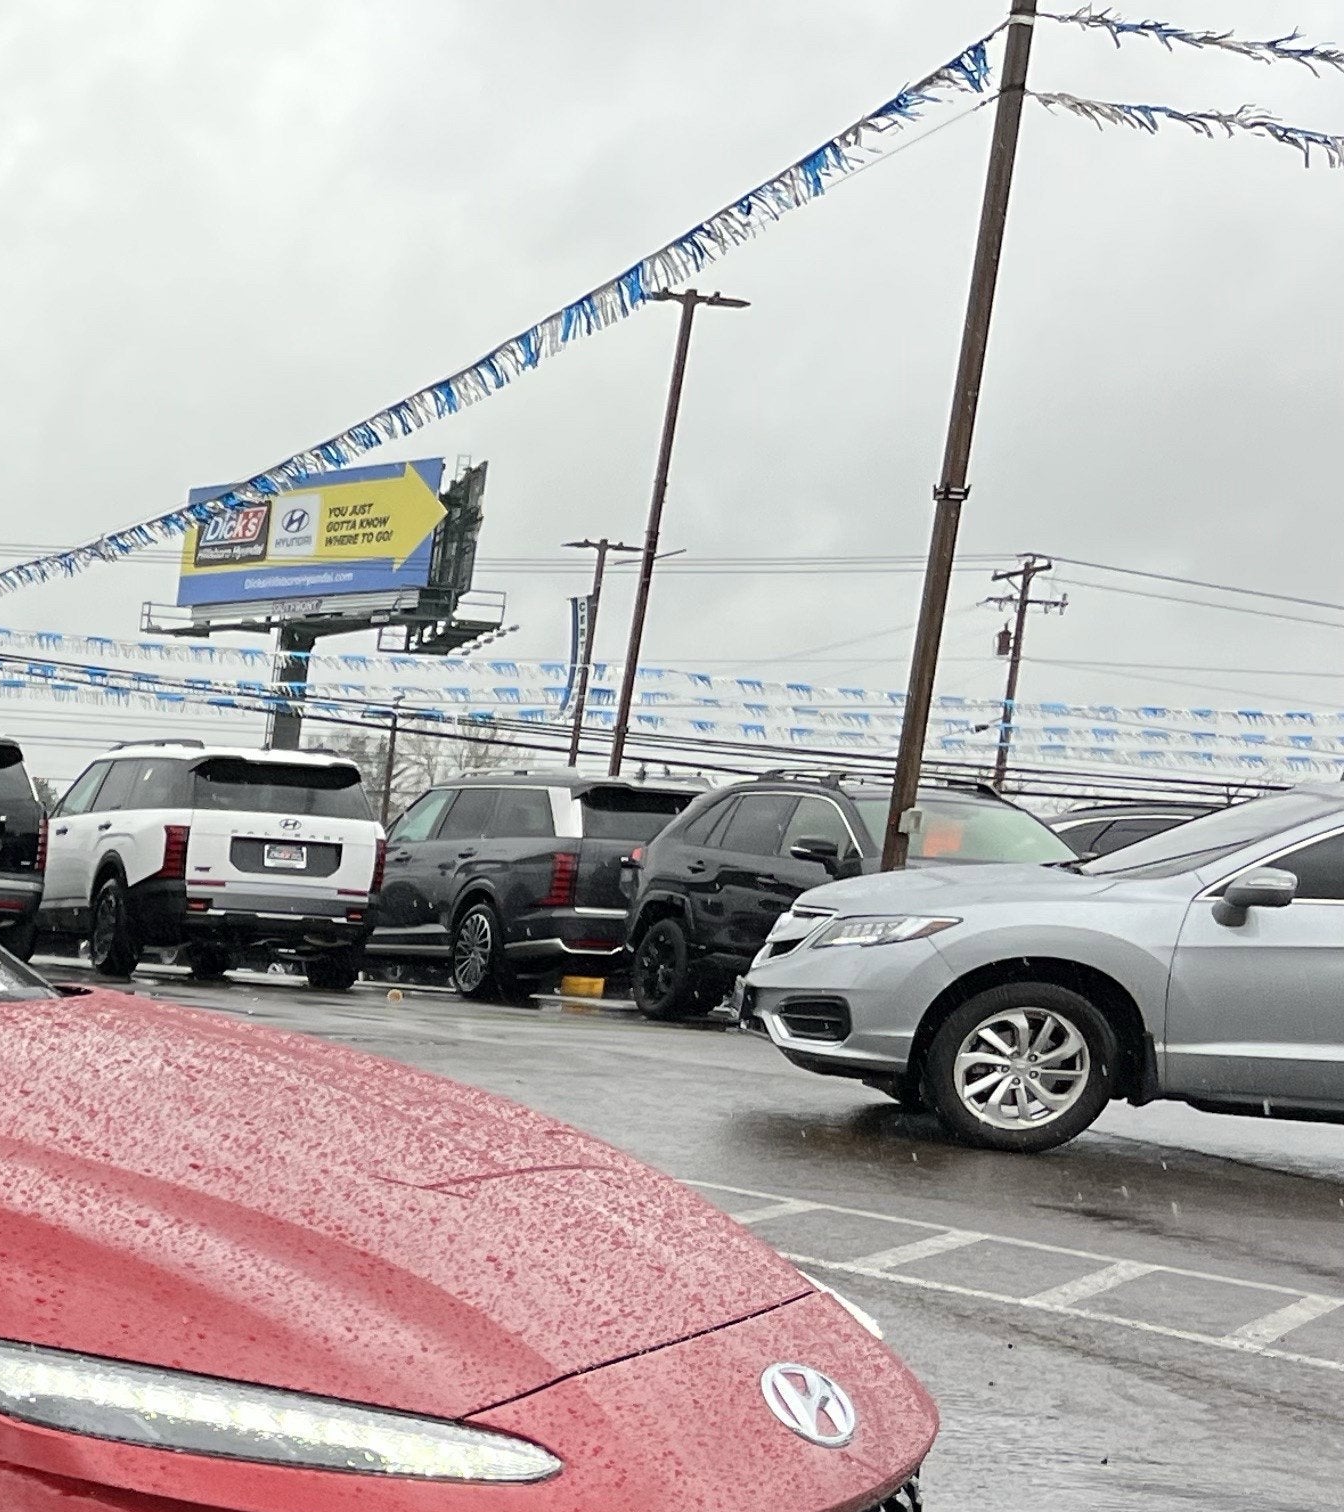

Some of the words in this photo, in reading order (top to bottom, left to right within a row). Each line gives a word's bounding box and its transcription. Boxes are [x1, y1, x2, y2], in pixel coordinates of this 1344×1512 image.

[328, 506, 348, 518] YOU
[349, 503, 374, 516] JUST
[326, 519, 357, 532] GOTTA
[358, 515, 390, 529] KNOW
[275, 535, 312, 548] HYUNDAI
[324, 533, 359, 547] WHERE
[361, 531, 374, 543] TO
[376, 530, 394, 542] GO!
